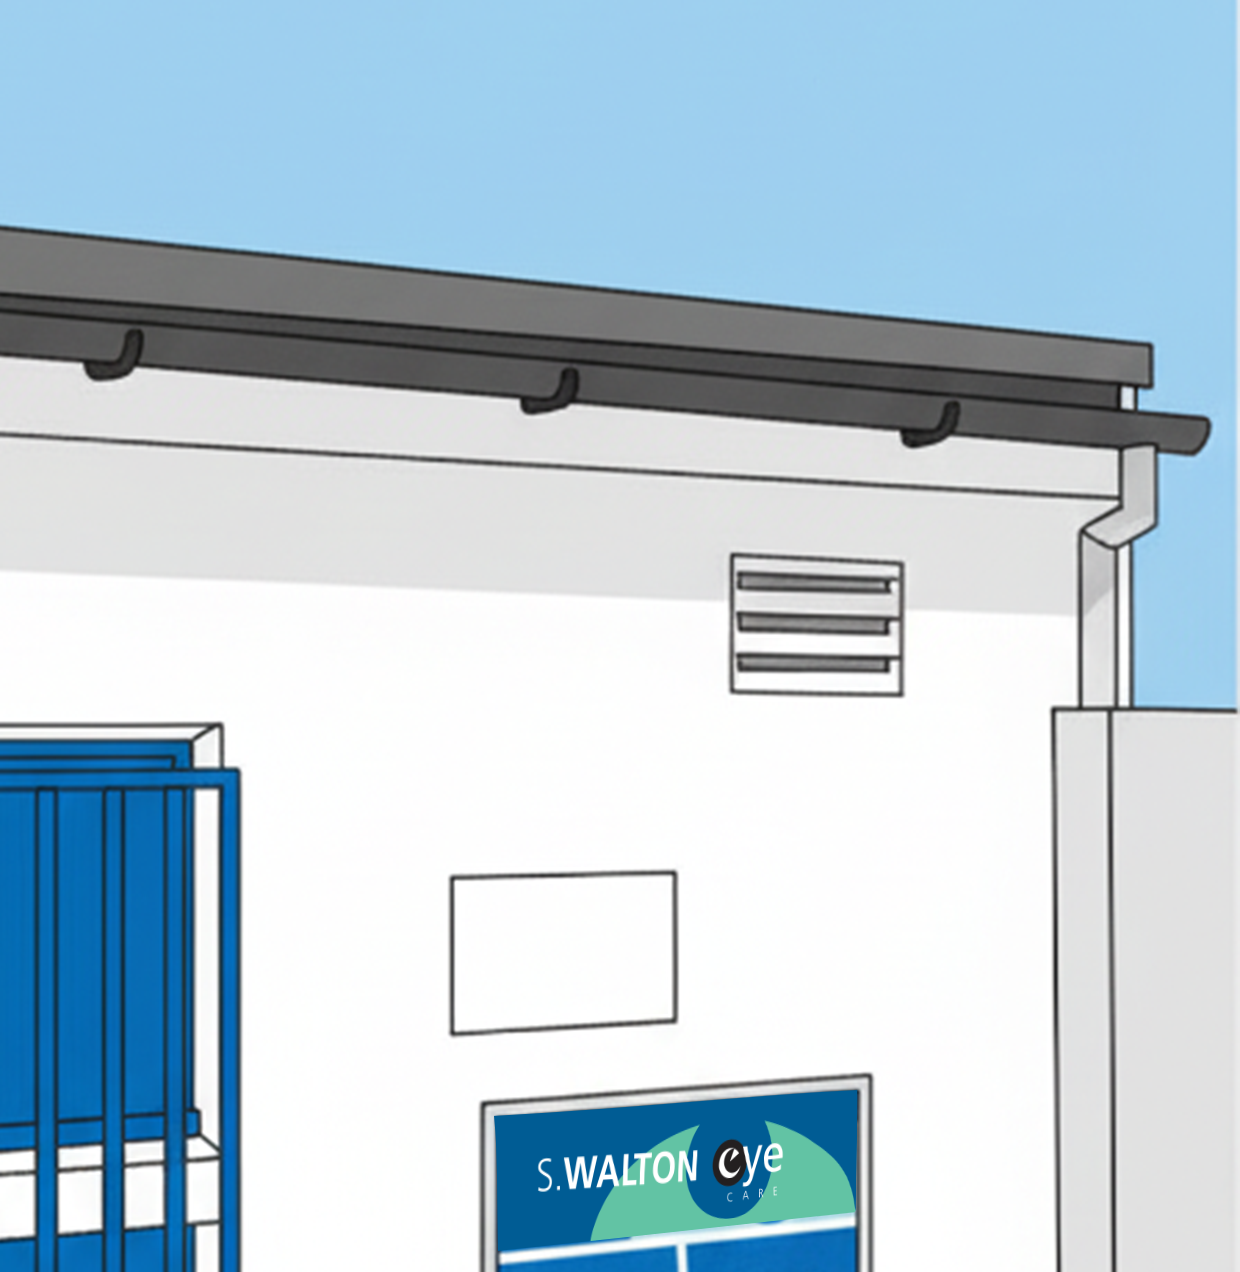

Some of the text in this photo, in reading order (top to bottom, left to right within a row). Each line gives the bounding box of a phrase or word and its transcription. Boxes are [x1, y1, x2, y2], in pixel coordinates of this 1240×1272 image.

[537, 1142, 784, 1192] S.WALTON eye
[726, 1186, 778, 1202] CARE
